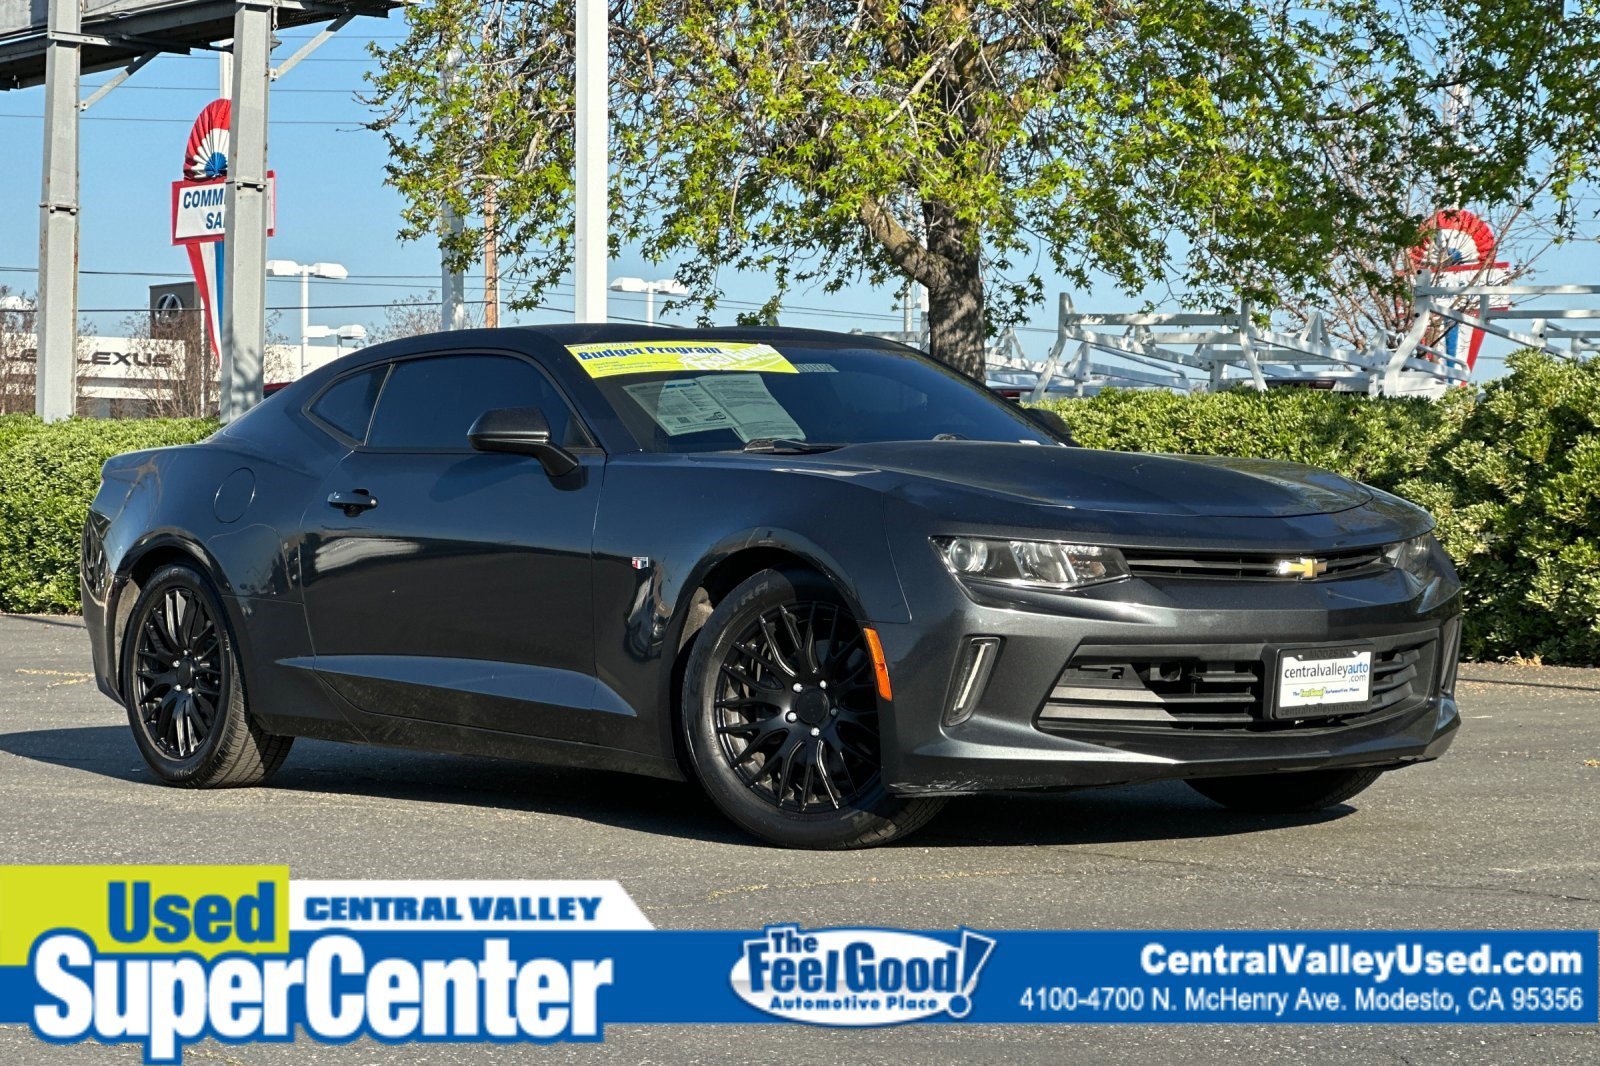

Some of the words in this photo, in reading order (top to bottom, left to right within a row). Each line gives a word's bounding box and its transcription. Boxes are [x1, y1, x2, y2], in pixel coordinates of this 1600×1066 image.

[183, 188, 226, 209] COMM
[206, 212, 225, 230] SA
[578, 347, 644, 361] Budget
[644, 346, 723, 355] Program
[1284, 662, 1368, 679] centralvalleyauto
